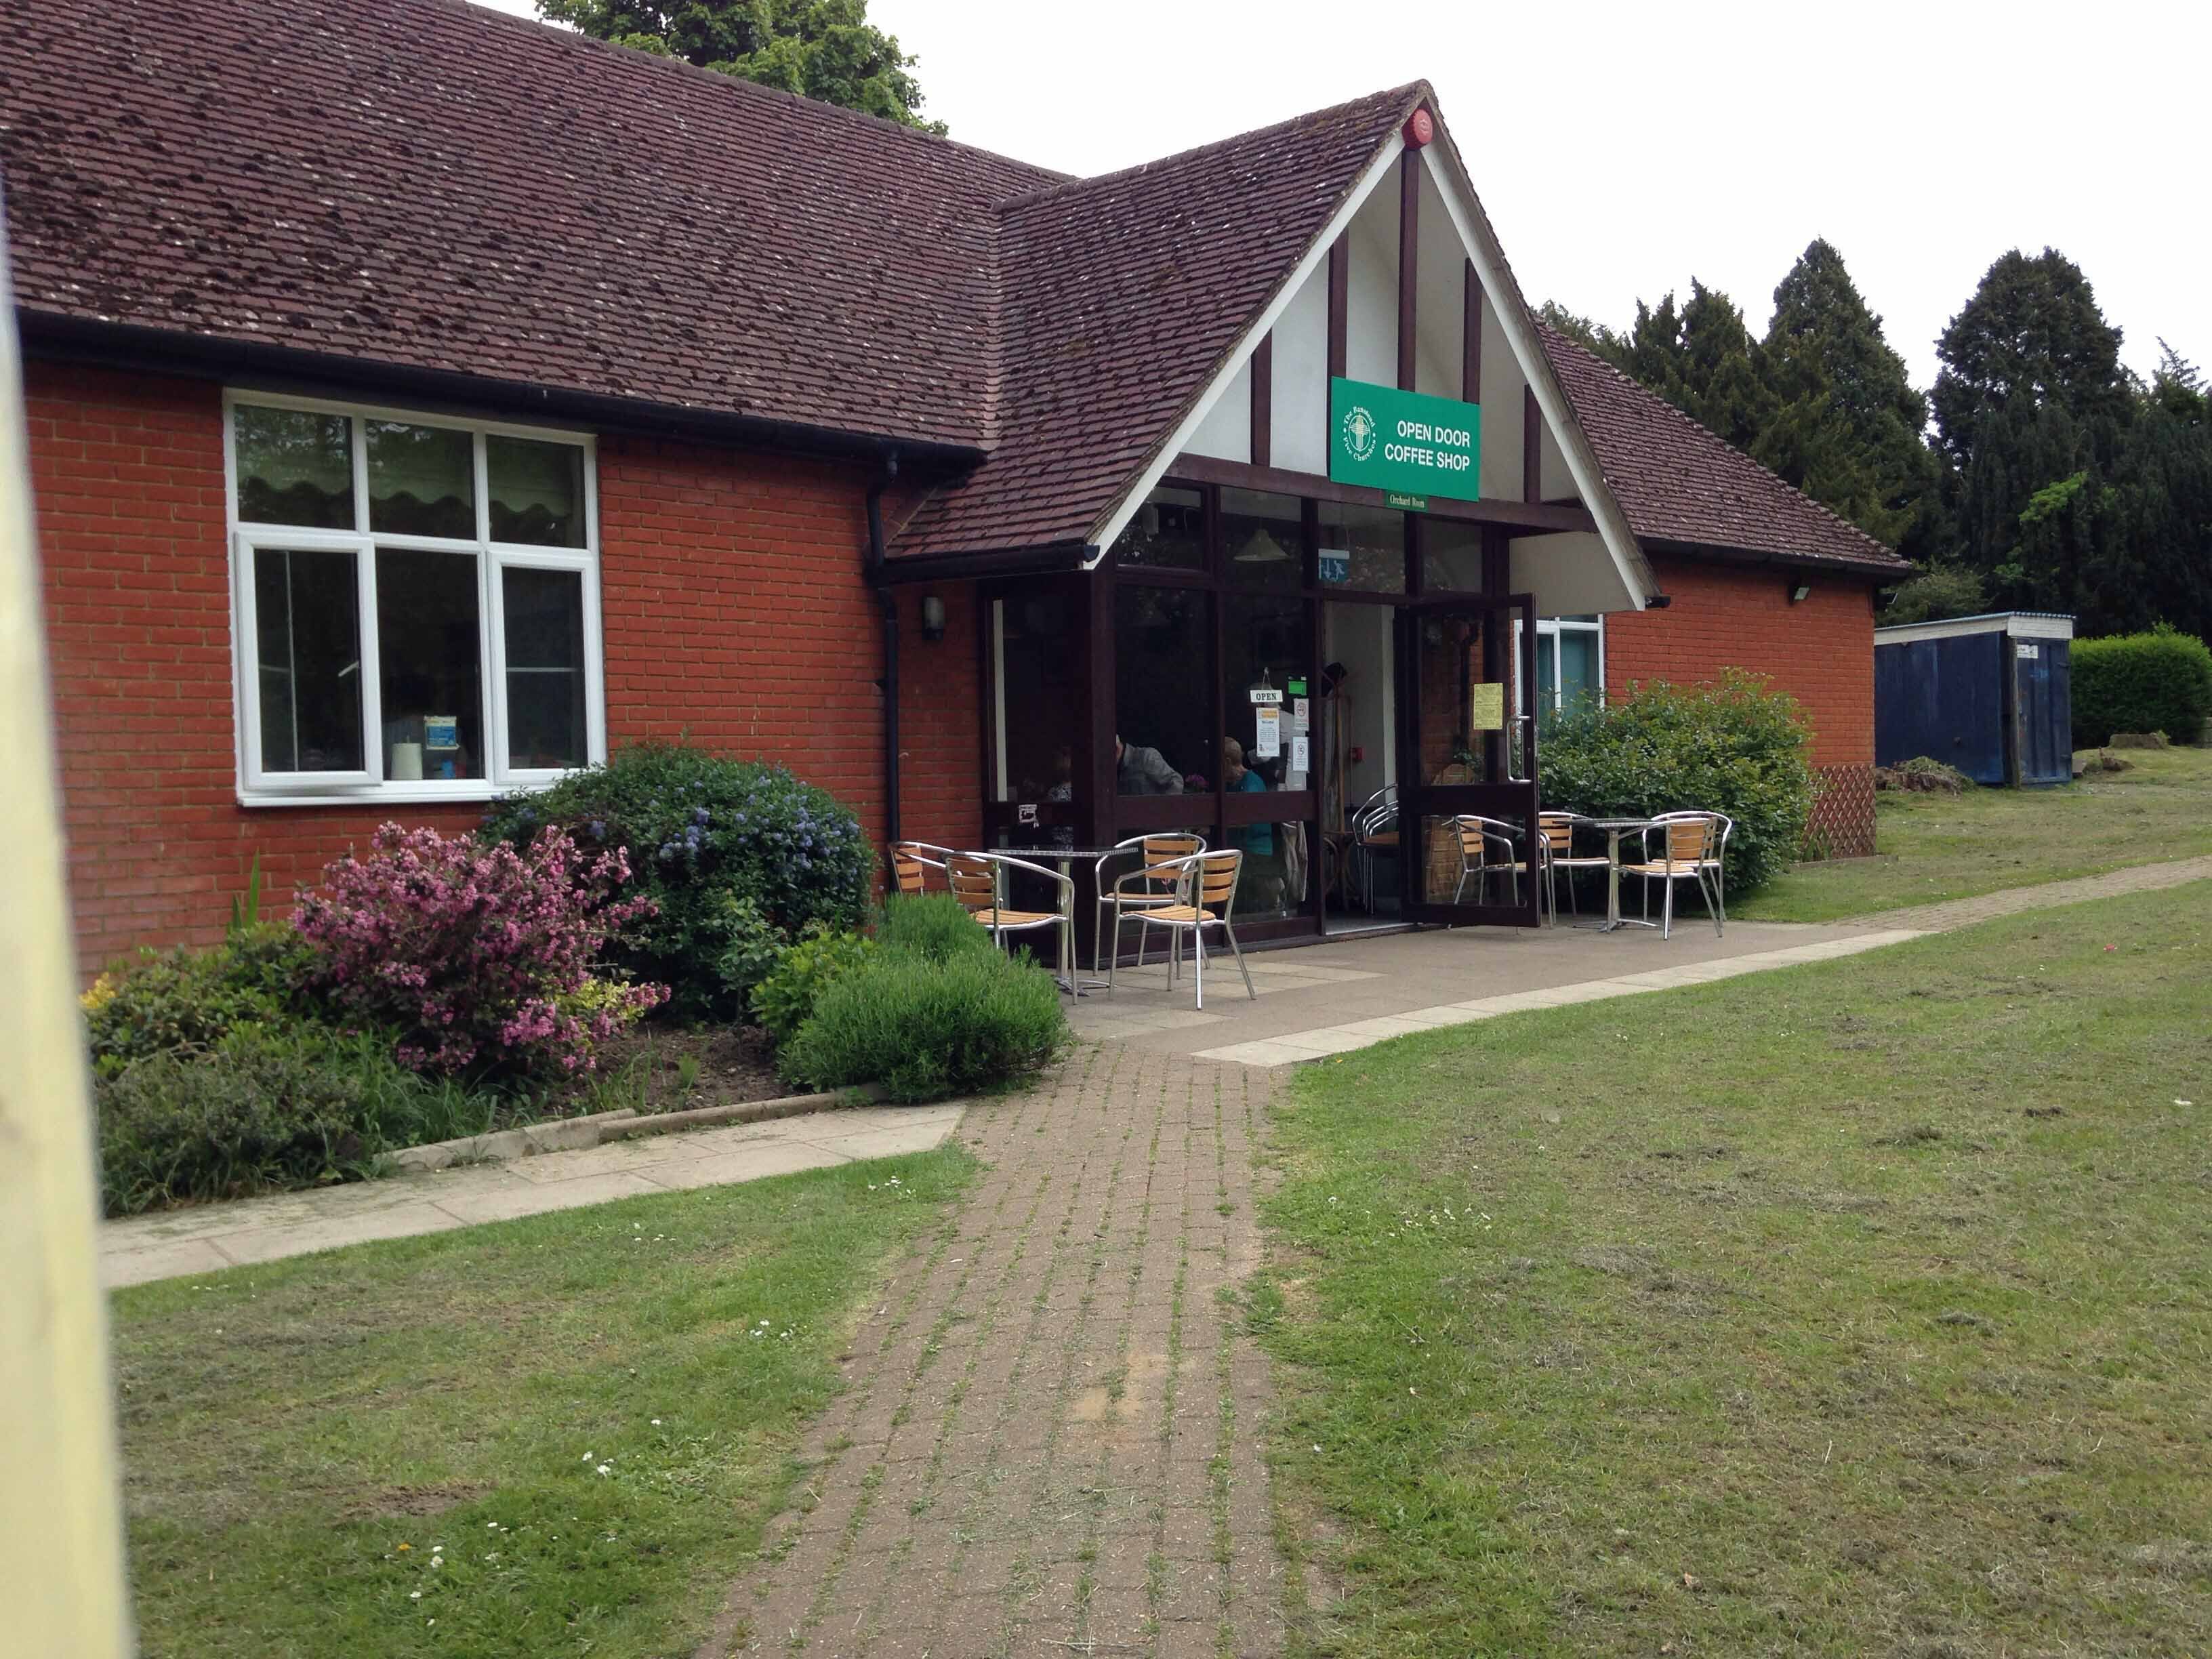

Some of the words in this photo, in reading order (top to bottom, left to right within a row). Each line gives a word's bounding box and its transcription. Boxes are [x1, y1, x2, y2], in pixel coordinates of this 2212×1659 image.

[1397, 420, 1431, 442] OPEN
[1435, 426, 1470, 448] DOOR
[1385, 443, 1434, 466] COFFEE
[1437, 451, 1470, 471] SHOP
[1389, 494, 1410, 506] Orchard
[1256, 693, 1277, 701] OPEN
